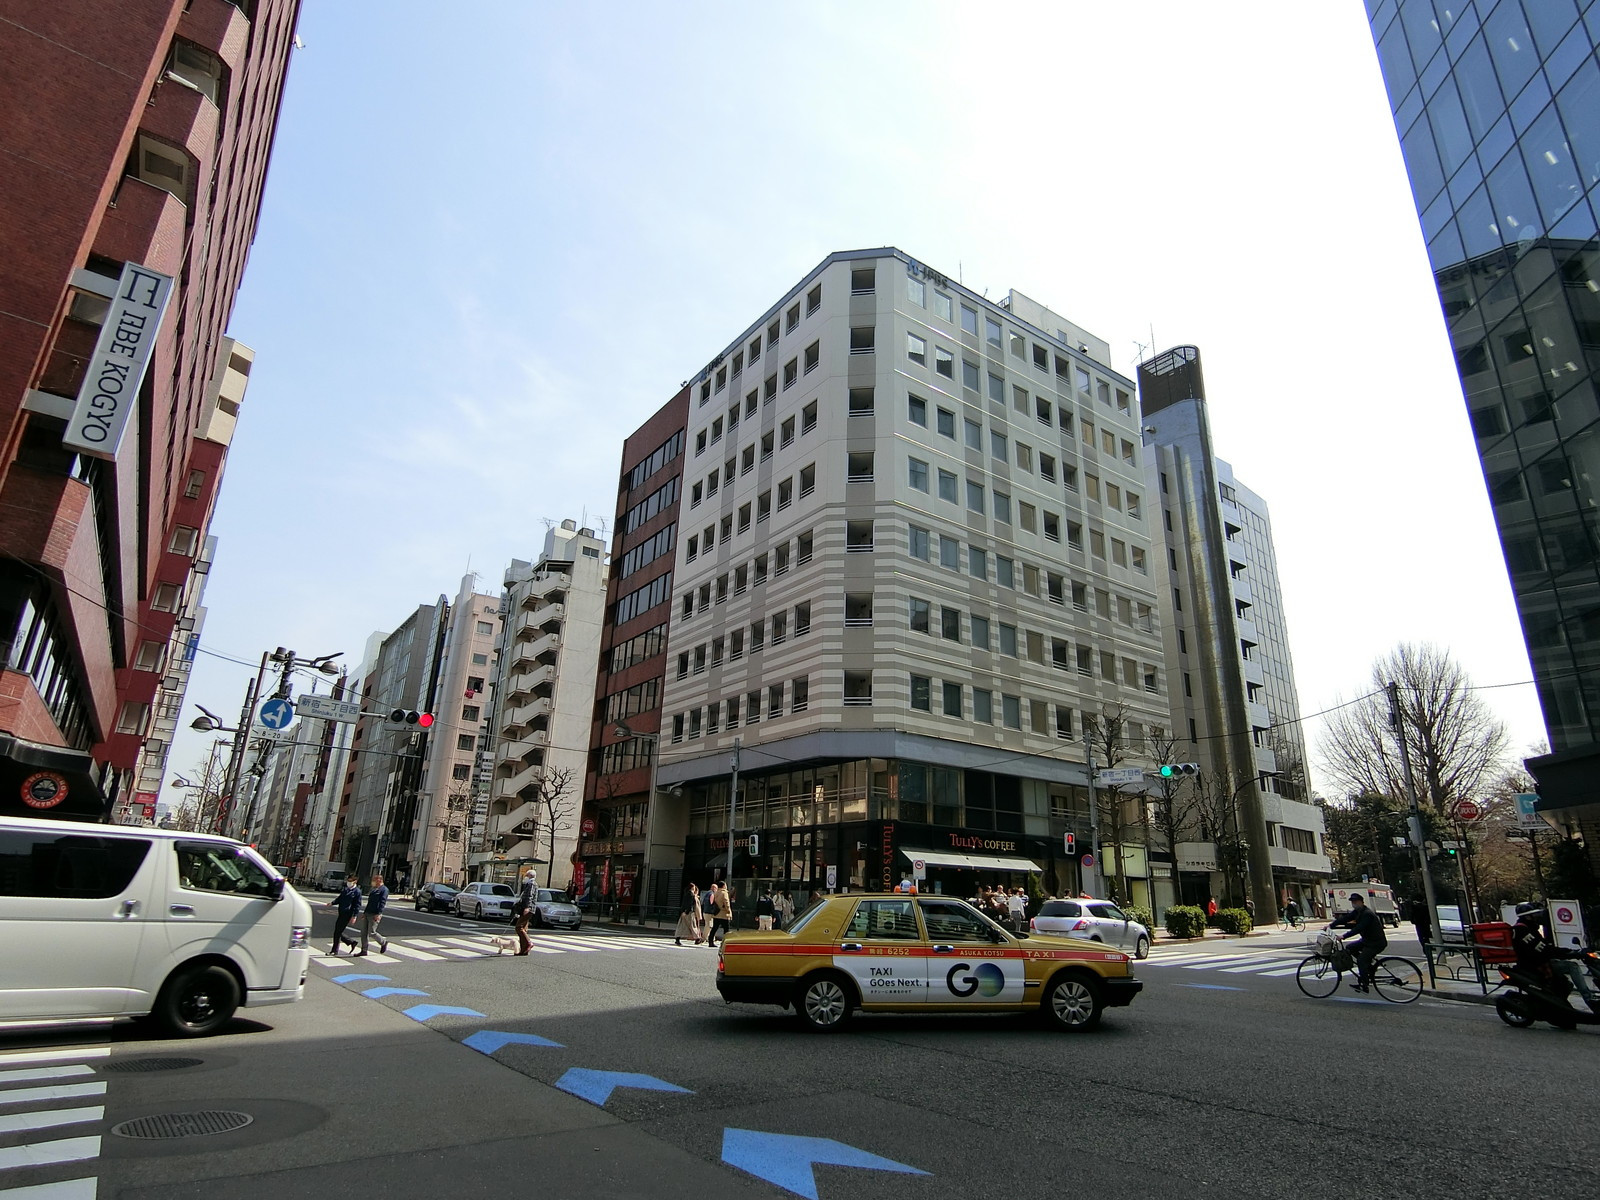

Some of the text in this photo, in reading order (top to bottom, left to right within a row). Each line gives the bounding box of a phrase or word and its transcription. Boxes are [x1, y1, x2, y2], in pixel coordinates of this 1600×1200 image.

[81, 360, 130, 442] KOGYO
[300, 697, 358, 714] 新宿一丁目西
[311, 708, 332, 717] Shinjuku
[261, 731, 281, 739] 8-20
[984, 839, 1017, 851] COFFEE
[870, 967, 893, 976] TAXI
[870, 978, 922, 987] GOes Next.
[946, 962, 1005, 997] GO
